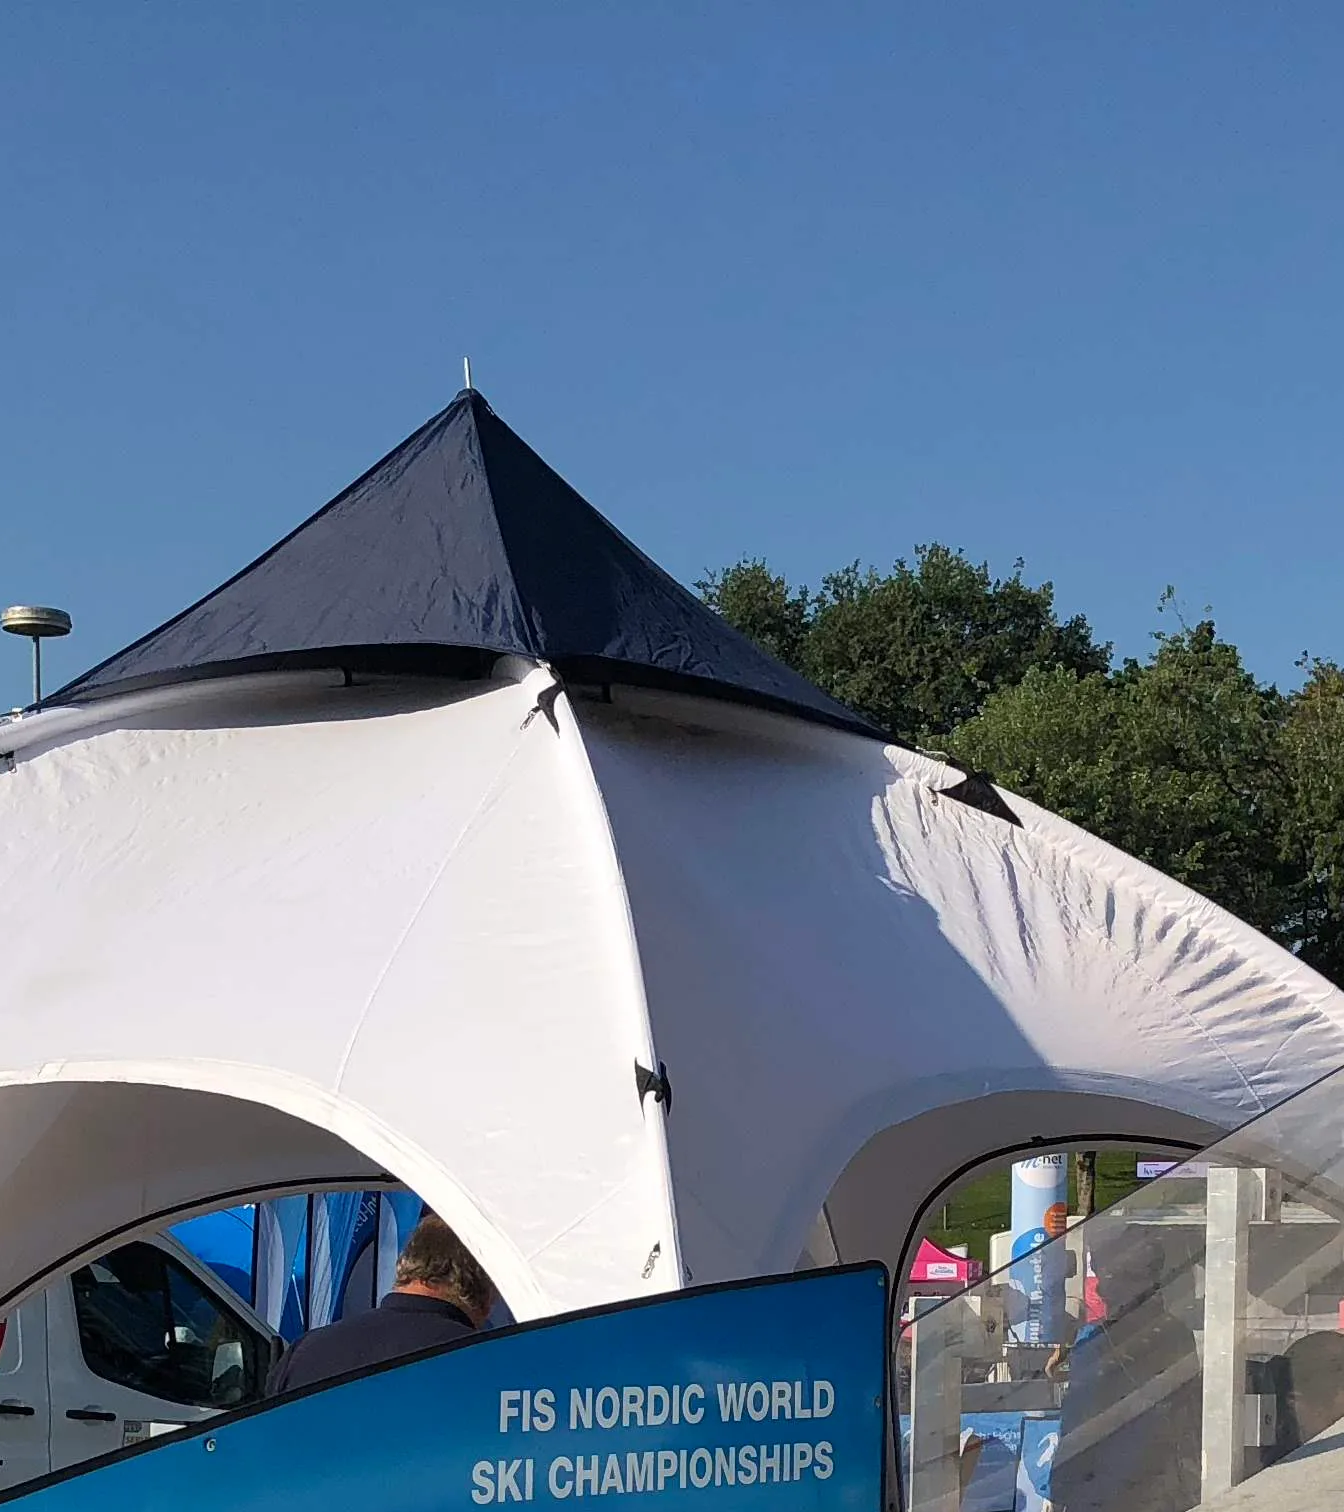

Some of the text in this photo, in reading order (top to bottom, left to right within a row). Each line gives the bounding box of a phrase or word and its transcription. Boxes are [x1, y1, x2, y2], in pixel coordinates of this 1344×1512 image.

[499, 1379, 836, 1433] FIS NORDIC WORLD
[470, 1440, 835, 1505] SKI CHAMPIONSHIPS
